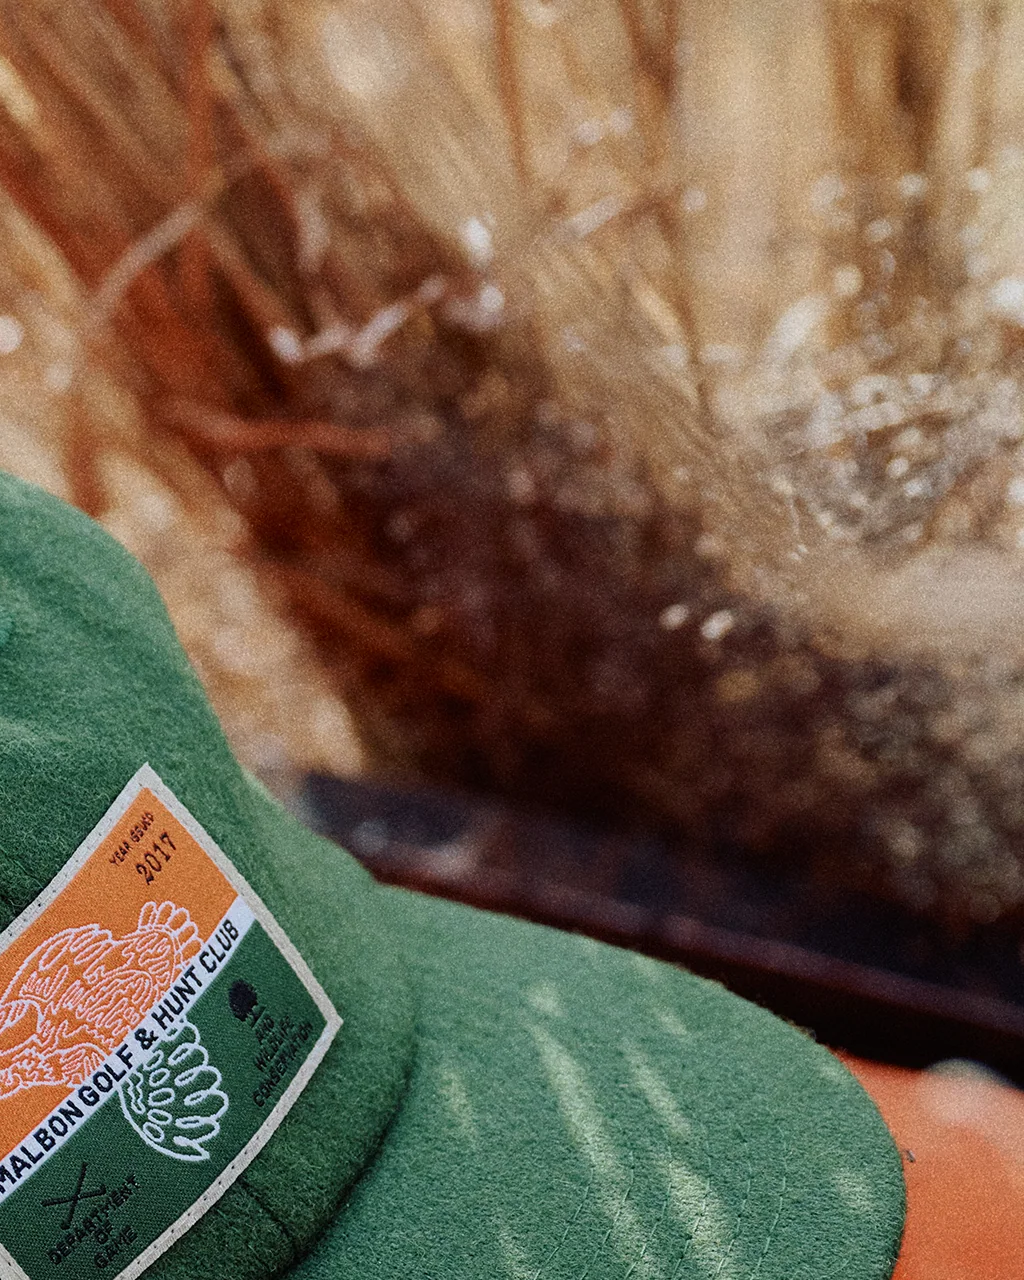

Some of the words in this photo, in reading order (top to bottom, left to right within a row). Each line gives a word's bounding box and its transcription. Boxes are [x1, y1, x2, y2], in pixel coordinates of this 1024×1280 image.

[109, 840, 133, 866] YEAR
[136, 831, 176, 885] 2017
[78, 1044, 134, 1106] GOLF
[134, 1028, 159, 1050] &
[151, 965, 203, 1030] HUNT
[199, 918, 239, 973] CLUB
[48, 1174, 141, 1265] DEPARTMENT
[96, 1220, 114, 1244] OF
[94, 1226, 138, 1268] GAME
